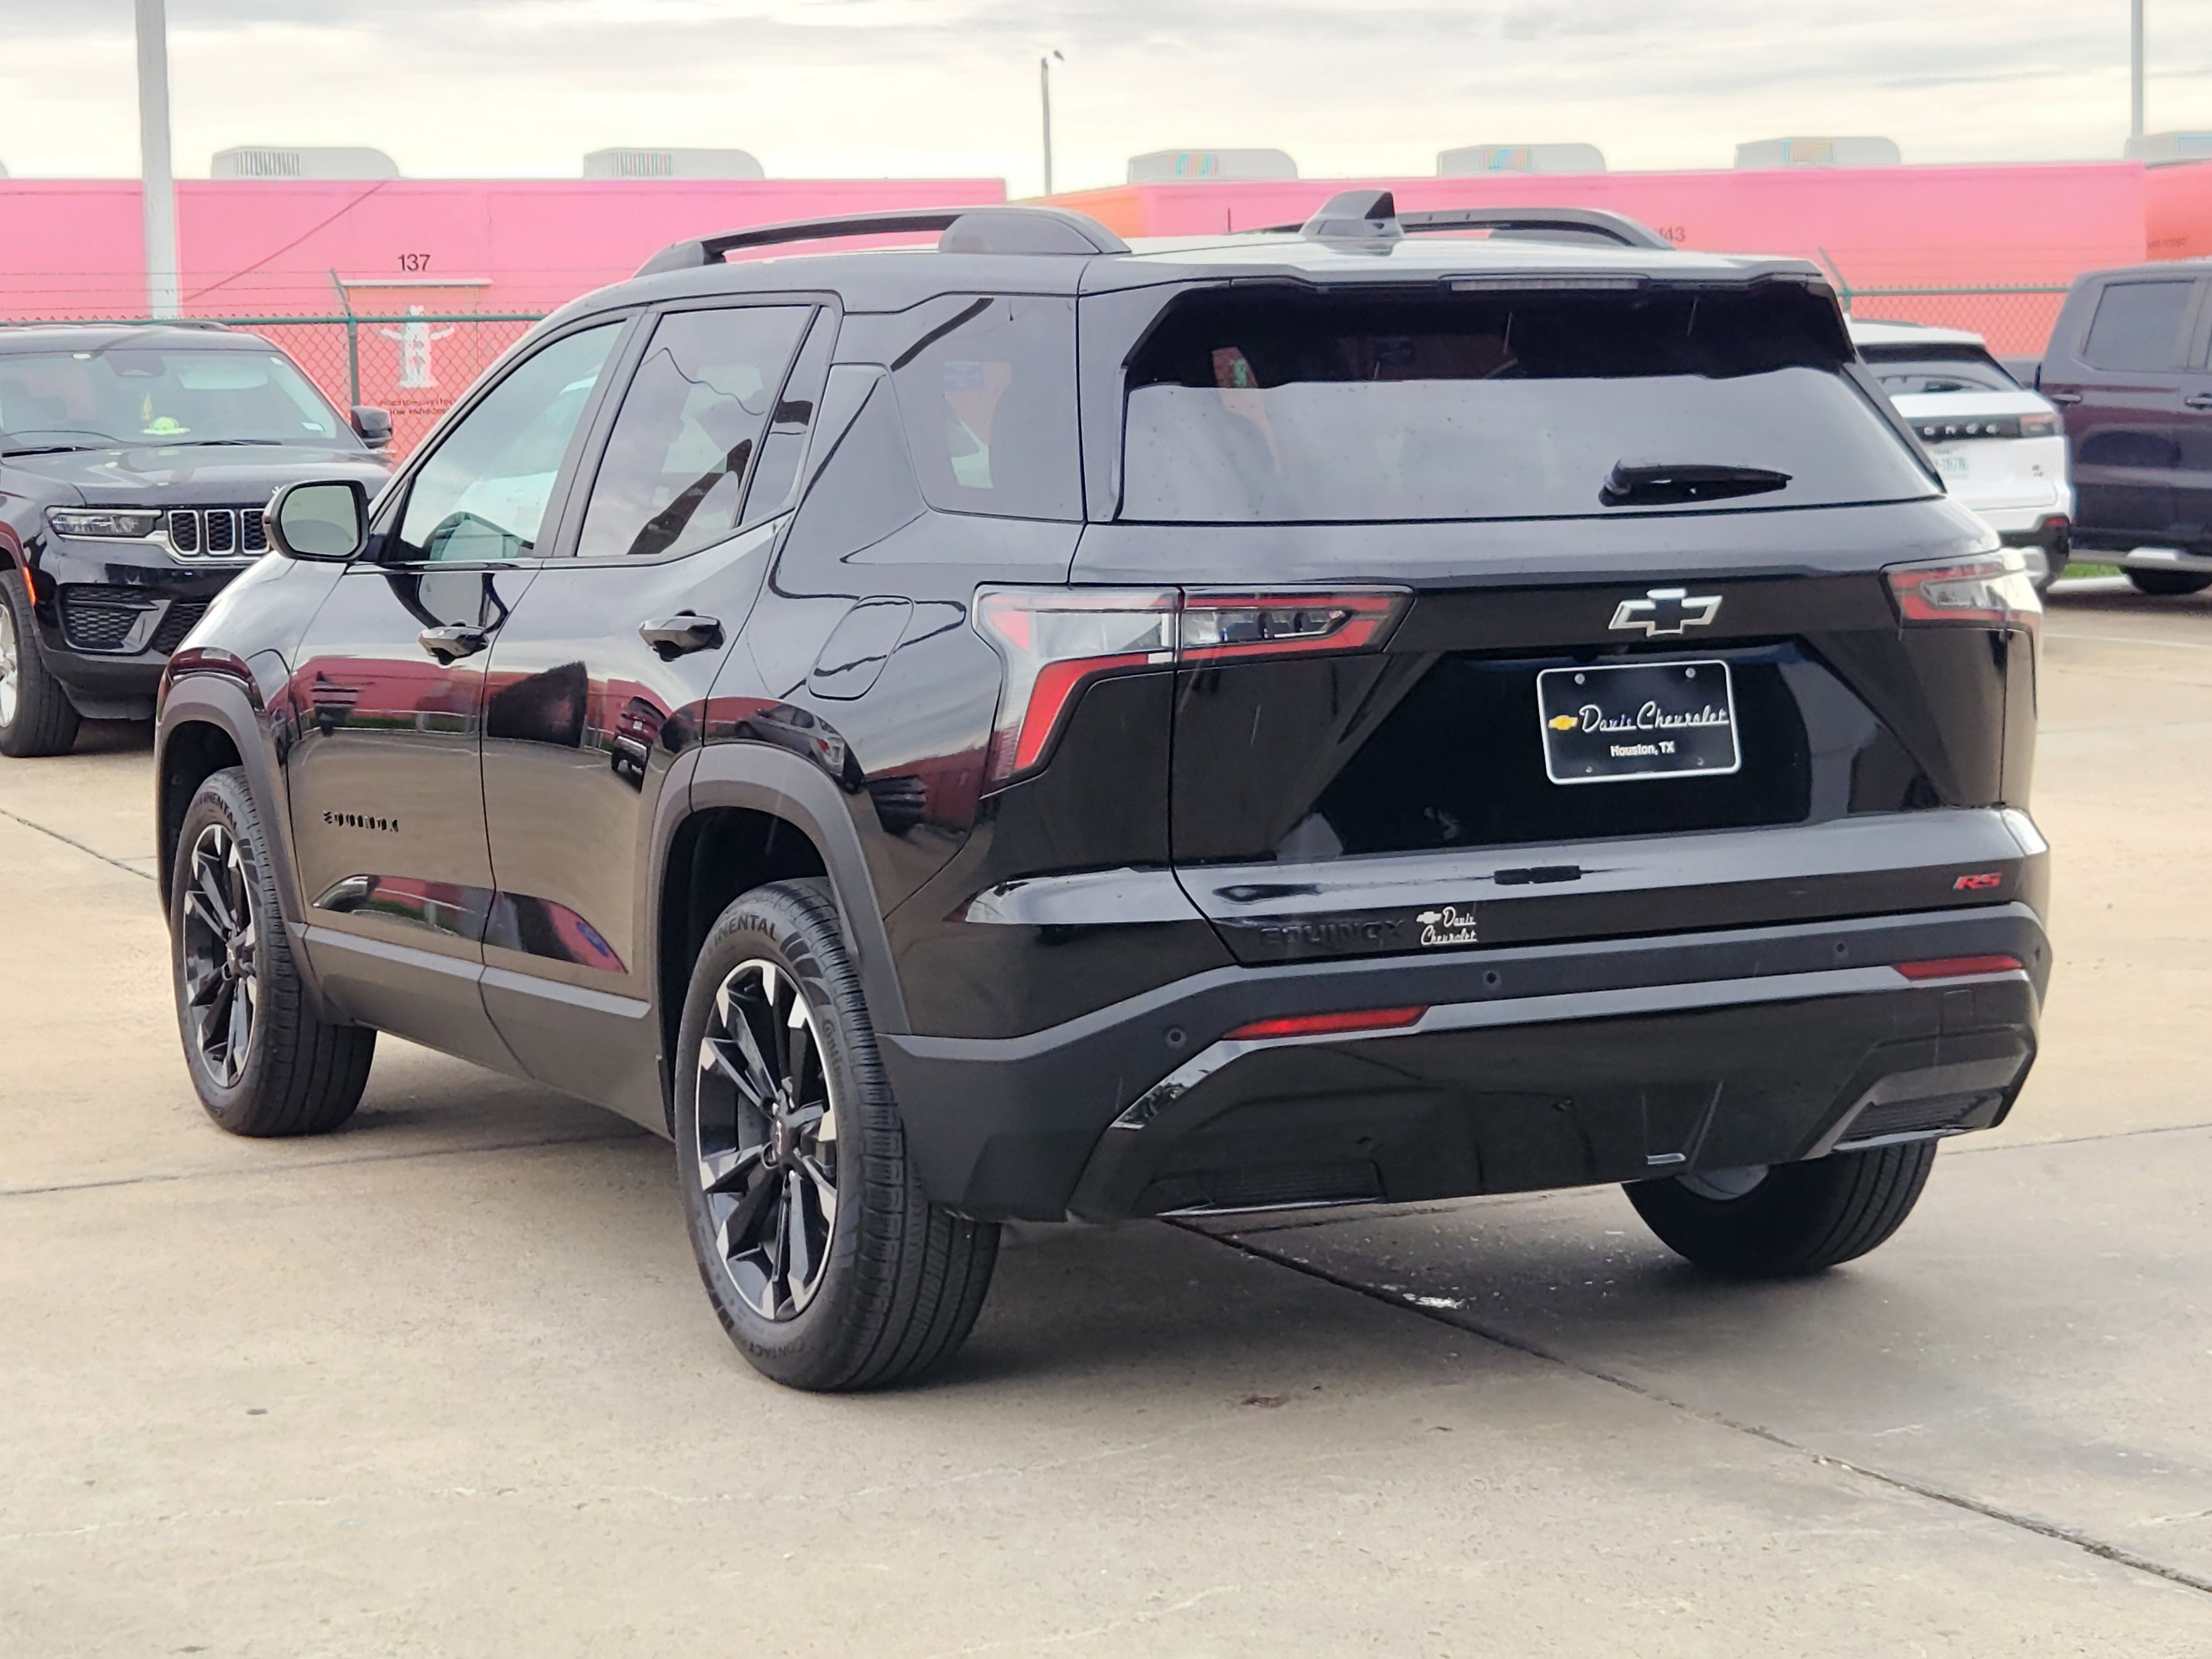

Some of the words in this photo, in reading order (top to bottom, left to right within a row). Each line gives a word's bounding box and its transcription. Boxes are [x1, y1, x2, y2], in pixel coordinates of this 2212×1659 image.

[398, 254, 431, 271] 137
[1579, 704, 1636, 733] Davis
[1637, 700, 1729, 730] Chevrolet
[1610, 744, 1658, 757] Houston,
[1659, 741, 1675, 753] TX
[1953, 872, 2003, 890] RS
[1443, 906, 1476, 927] Davis
[1260, 919, 1406, 945] EQUINOX
[1421, 925, 1478, 945] Chevrolet
